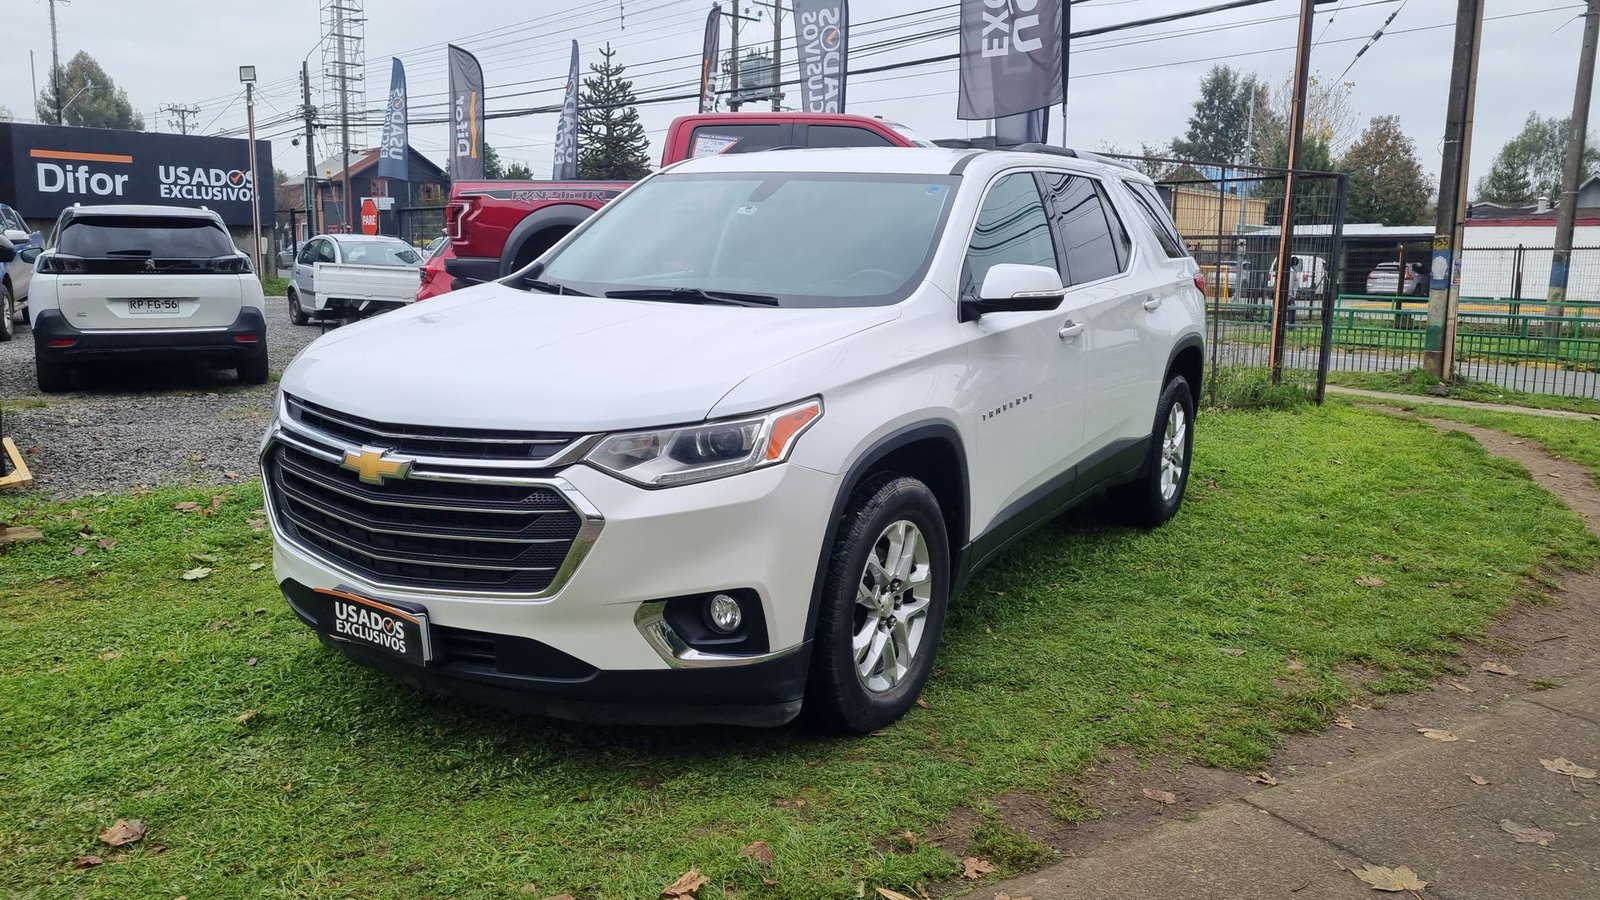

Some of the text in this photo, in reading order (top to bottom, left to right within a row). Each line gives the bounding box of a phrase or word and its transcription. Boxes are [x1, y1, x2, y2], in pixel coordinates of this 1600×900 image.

[37, 162, 129, 196] Difor
[158, 165, 253, 189] USADOS
[512, 190, 608, 205] RAPTOR
[362, 214, 377, 226] PARE
[334, 601, 405, 639] USADOS
[335, 619, 407, 654] EXCLUSIVOS
